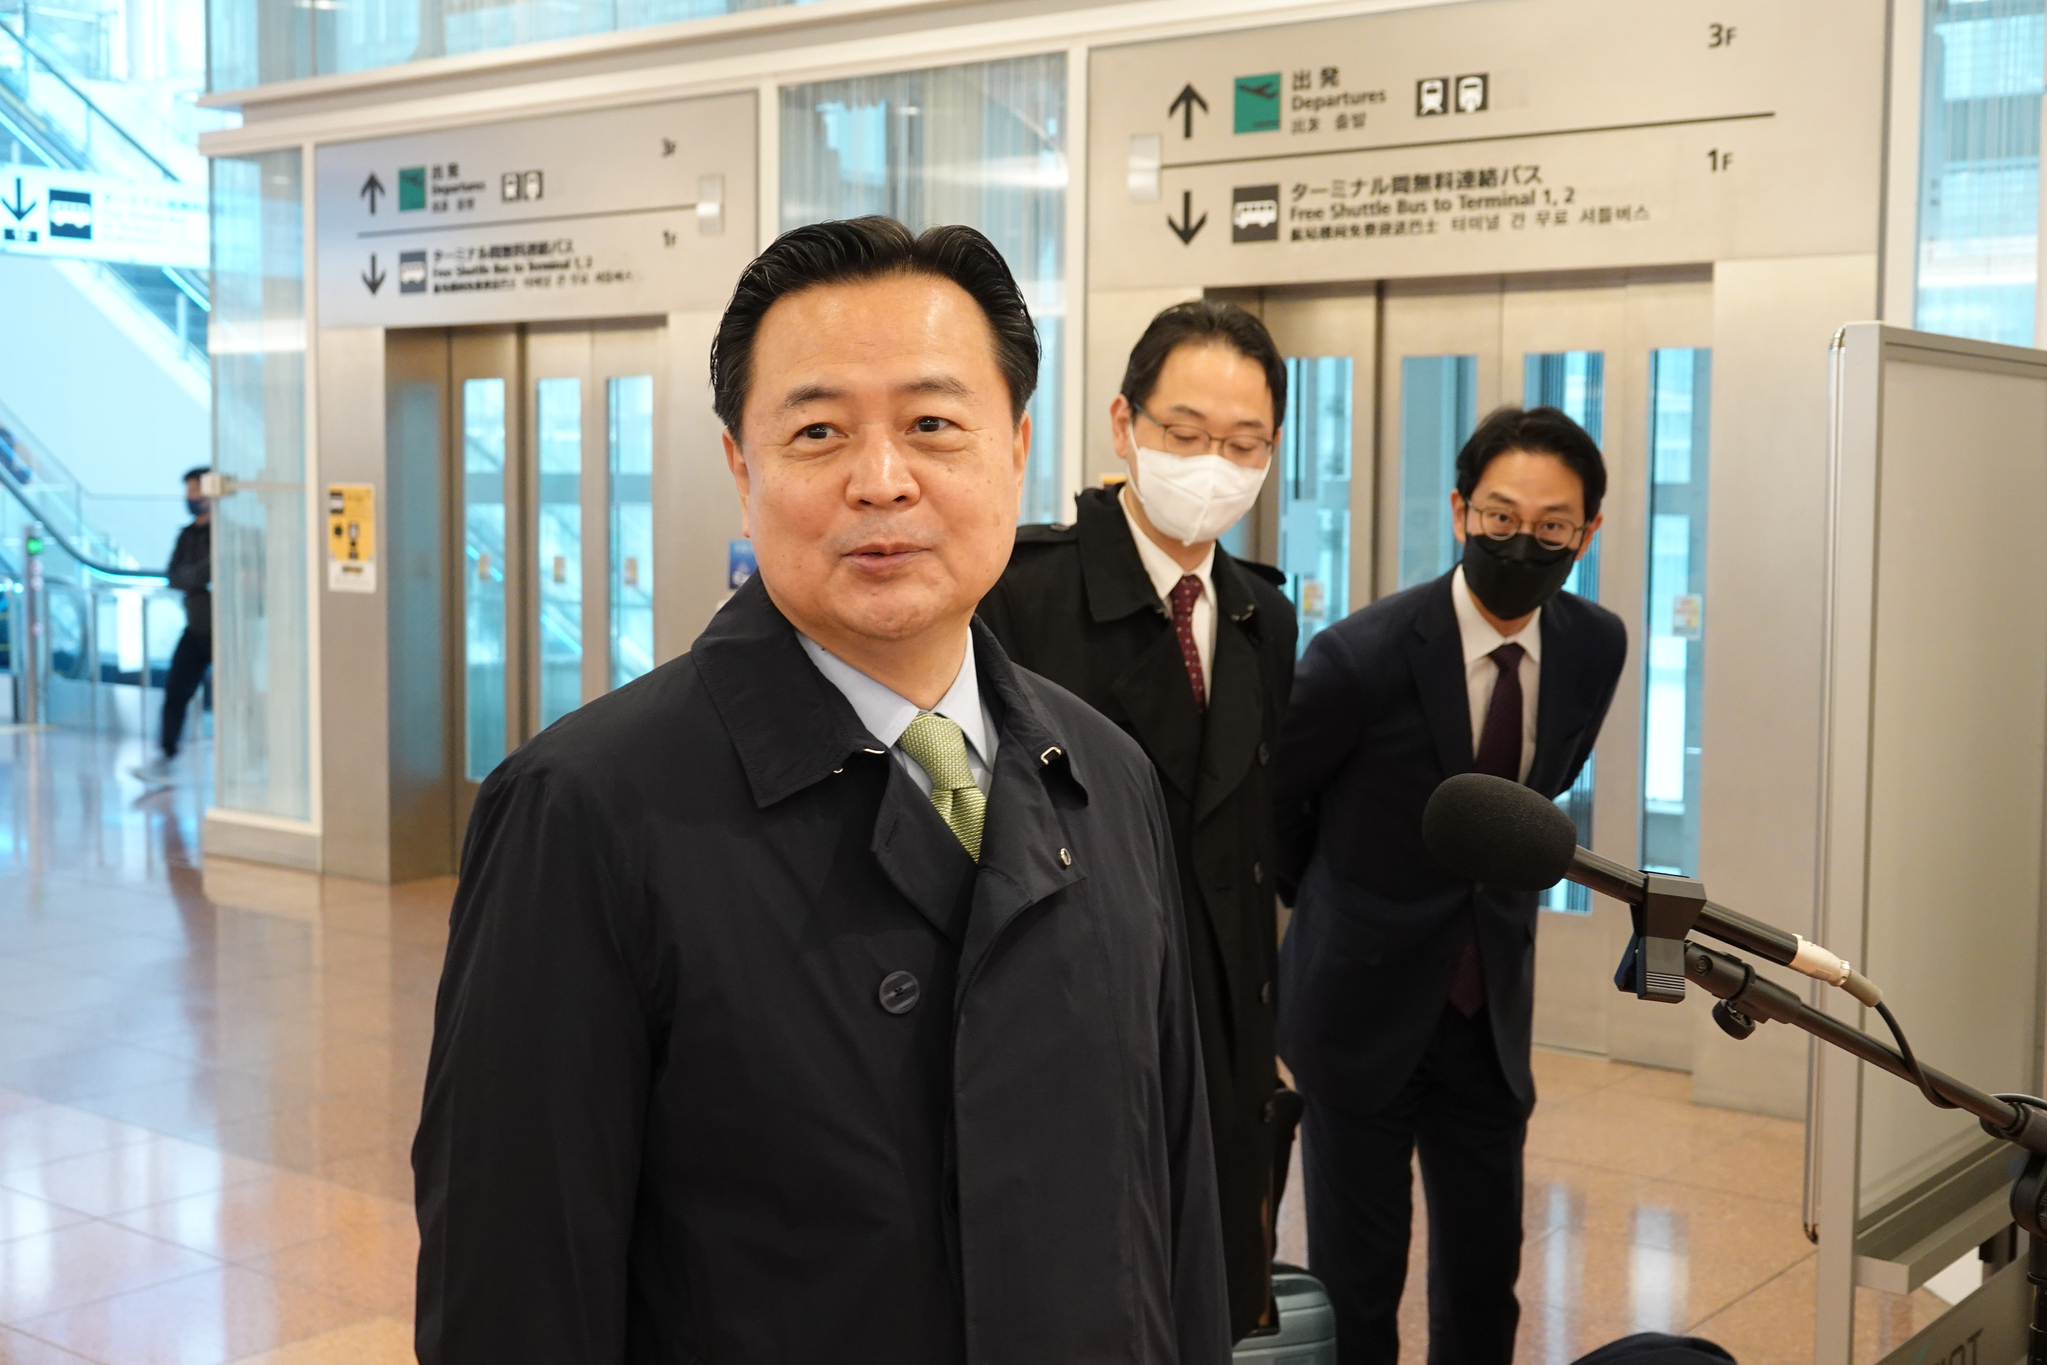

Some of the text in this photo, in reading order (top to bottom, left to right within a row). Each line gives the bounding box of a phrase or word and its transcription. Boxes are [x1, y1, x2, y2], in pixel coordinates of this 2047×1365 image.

[1708, 22, 1737, 49] 3F
[1292, 66, 1340, 91] 出発
[1292, 90, 1387, 112] Departures
[1707, 148, 1734, 172] 1F
[1291, 165, 1543, 202] ターミナル間無料連絡バス
[1290, 205, 1324, 221] Free
[1330, 200, 1392, 219] Shuttle
[1397, 199, 1428, 215] Bus
[1433, 198, 1452, 212] to
[1459, 189, 1537, 210] Terminal
[1564, 186, 1576, 204] 2
